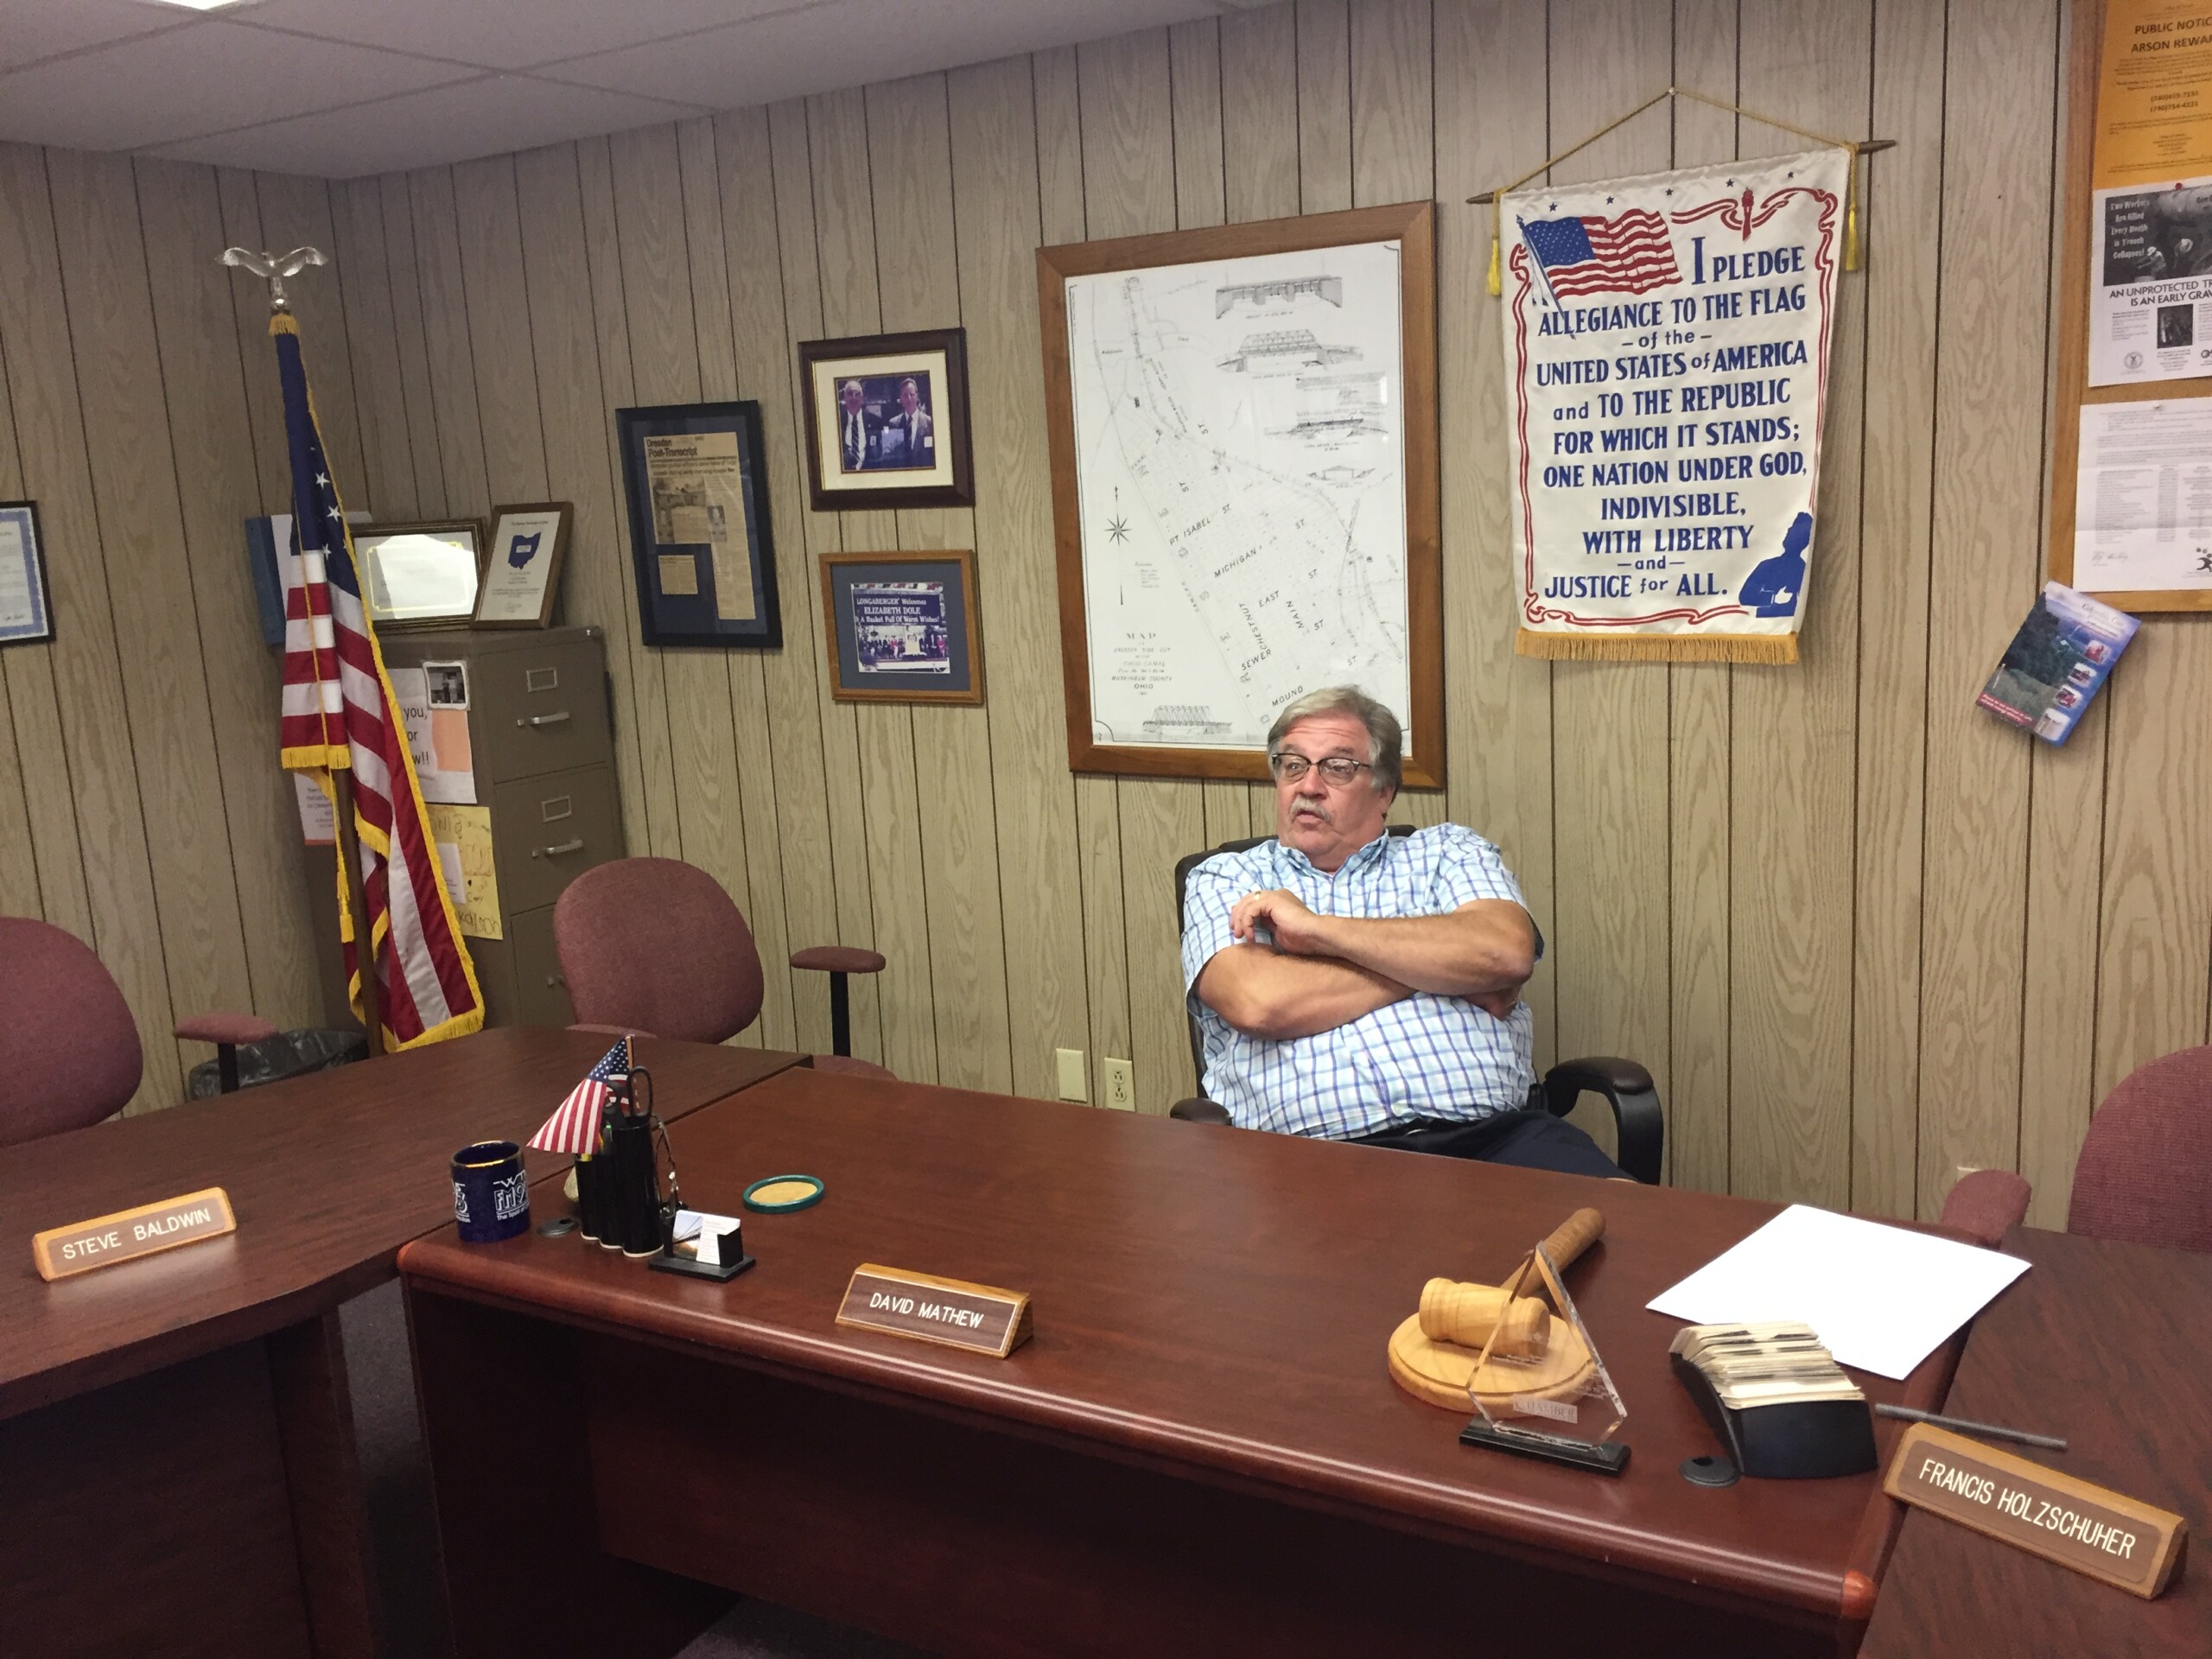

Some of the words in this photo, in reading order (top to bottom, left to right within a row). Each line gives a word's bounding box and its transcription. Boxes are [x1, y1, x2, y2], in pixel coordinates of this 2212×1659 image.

[2134, 22, 2173, 35] PUBLIC
[2131, 41, 2170, 53] ARSON
[1691, 236, 1707, 285] I
[1713, 245, 1806, 283] PLEDGE
[2109, 289, 2125, 299] AN
[2126, 281, 2199, 297] UNPROTECTED
[2131, 297, 2139, 307] IS
[2140, 295, 2156, 306] AN
[2158, 291, 2187, 303] EARLY
[1538, 301, 1663, 337] ALLEGIANCE
[1671, 298, 1697, 323] TO
[1702, 293, 1741, 321] THE
[1750, 285, 1806, 317] FLAG
[1638, 333, 1657, 350] of
[1664, 327, 1694, 346] the
[1536, 358, 1609, 387] UNITED
[1615, 353, 1686, 379] STATES
[1691, 353, 1710, 372] of
[1713, 340, 1808, 374] AMERICA
[1553, 403, 1589, 421] and
[1597, 392, 1623, 418] TO
[1632, 388, 1673, 416] THE
[1681, 378, 1791, 412] REPUBLIC
[1553, 430, 1593, 455] FOR
[1600, 425, 1668, 452] WHICH
[1677, 424, 1695, 449] IT
[1706, 416, 1800, 447] STANDS;
[1543, 465, 1585, 489] ONE
[1592, 461, 1669, 486] NATION
[1678, 454, 1752, 481] UNDER
[1759, 451, 1808, 478] GOD,
[1183, 516, 1211, 538] ISABEL
[1222, 503, 1231, 514] ST
[1600, 492, 1746, 520] INDIVISIBLE,
[1213, 547, 1256, 579] MICHIGAN
[1294, 518, 1305, 530] ST
[1582, 531, 1641, 554] WITH
[1655, 524, 1754, 552] LIBERTY
[1634, 556, 1667, 570] and
[1258, 590, 1281, 608] EAST
[1307, 569, 1319, 580] ST
[1544, 575, 1631, 600] JUSTICE
[1640, 577, 1669, 594] for
[1676, 572, 1728, 596] ALL.
[1239, 602, 1268, 650] CHESTNUT
[1286, 600, 1305, 630] MAIN
[1241, 649, 1272, 671] SEWER
[1313, 620, 1325, 631] ST
[1271, 685, 1304, 707] MOUND
[1347, 656, 1357, 666] ST
[404, 707, 427, 721] you,
[62, 1231, 122, 1259] STEVE
[133, 1208, 211, 1241] BALDWIN
[869, 1293, 913, 1314] DAVID
[918, 1302, 984, 1328] MATHEW
[1919, 1459, 1995, 1504] FRANCIS
[1998, 1487, 2136, 1560] HOLZSCHUHER
